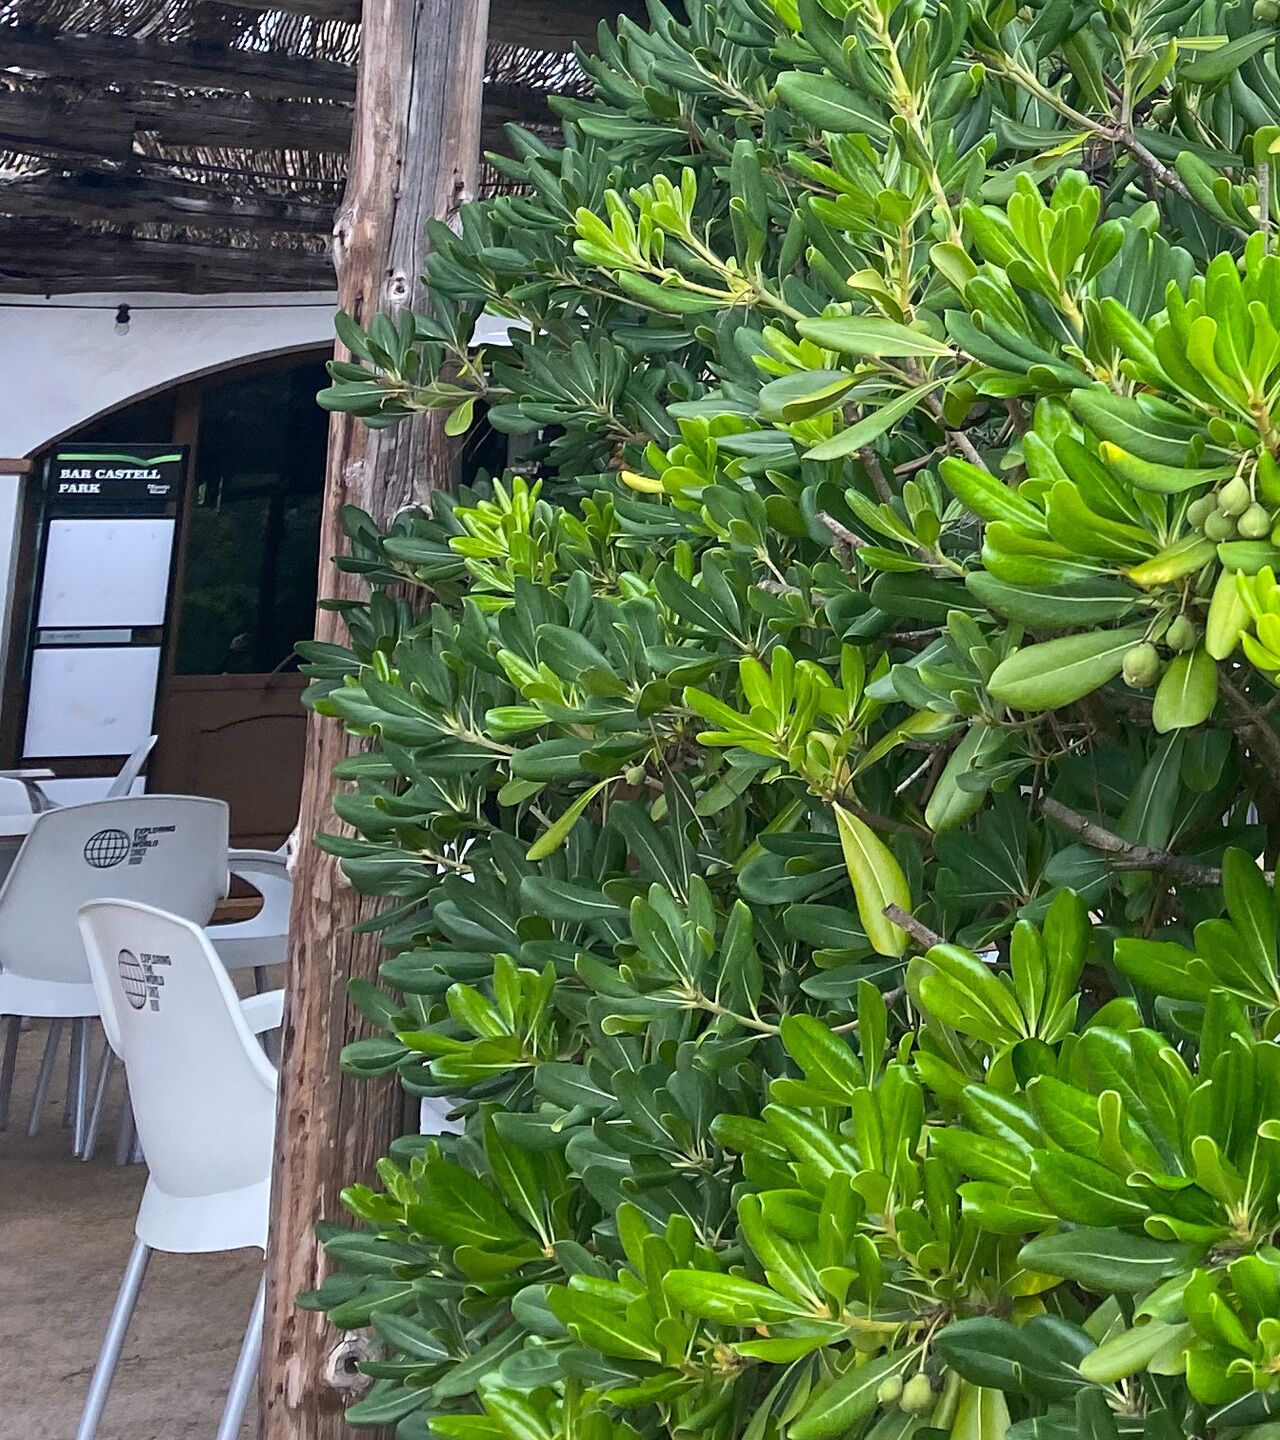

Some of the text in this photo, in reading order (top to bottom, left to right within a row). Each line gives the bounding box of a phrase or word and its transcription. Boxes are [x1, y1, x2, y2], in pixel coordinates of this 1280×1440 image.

[60, 469, 160, 479] BAR CASTELL
[59, 483, 100, 493] PARK
